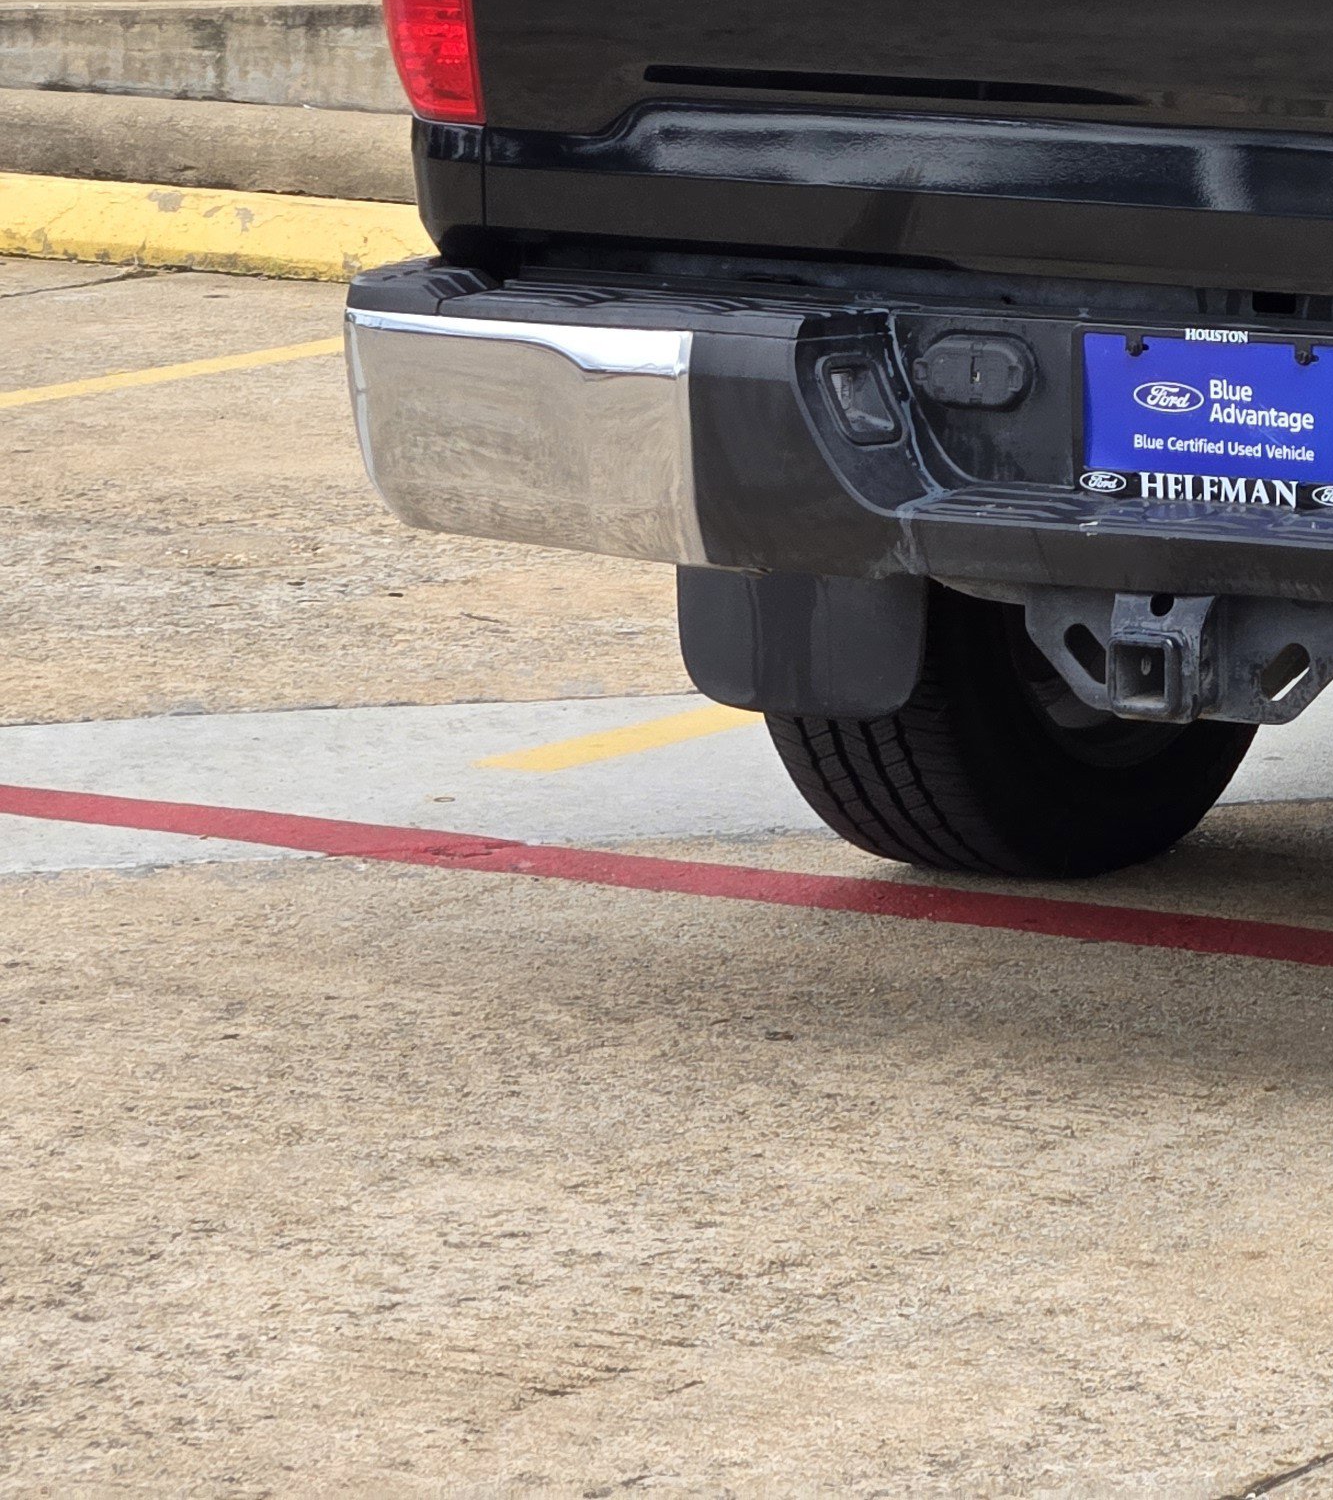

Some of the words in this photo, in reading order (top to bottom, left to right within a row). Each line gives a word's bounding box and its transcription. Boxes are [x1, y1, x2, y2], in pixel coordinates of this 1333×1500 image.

[1185, 328, 1249, 344] HOUSTON
[1145, 384, 1193, 410] Ford
[1209, 379, 1253, 402] Blue
[1209, 403, 1315, 432] Advantage
[1134, 433, 1164, 451] Blue
[1167, 436, 1224, 455] Certified
[1228, 441, 1262, 458] Used
[1265, 444, 1315, 461] Vehicle
[1086, 473, 1118, 491] Ford
[1140, 472, 1300, 508] HELFMAN
